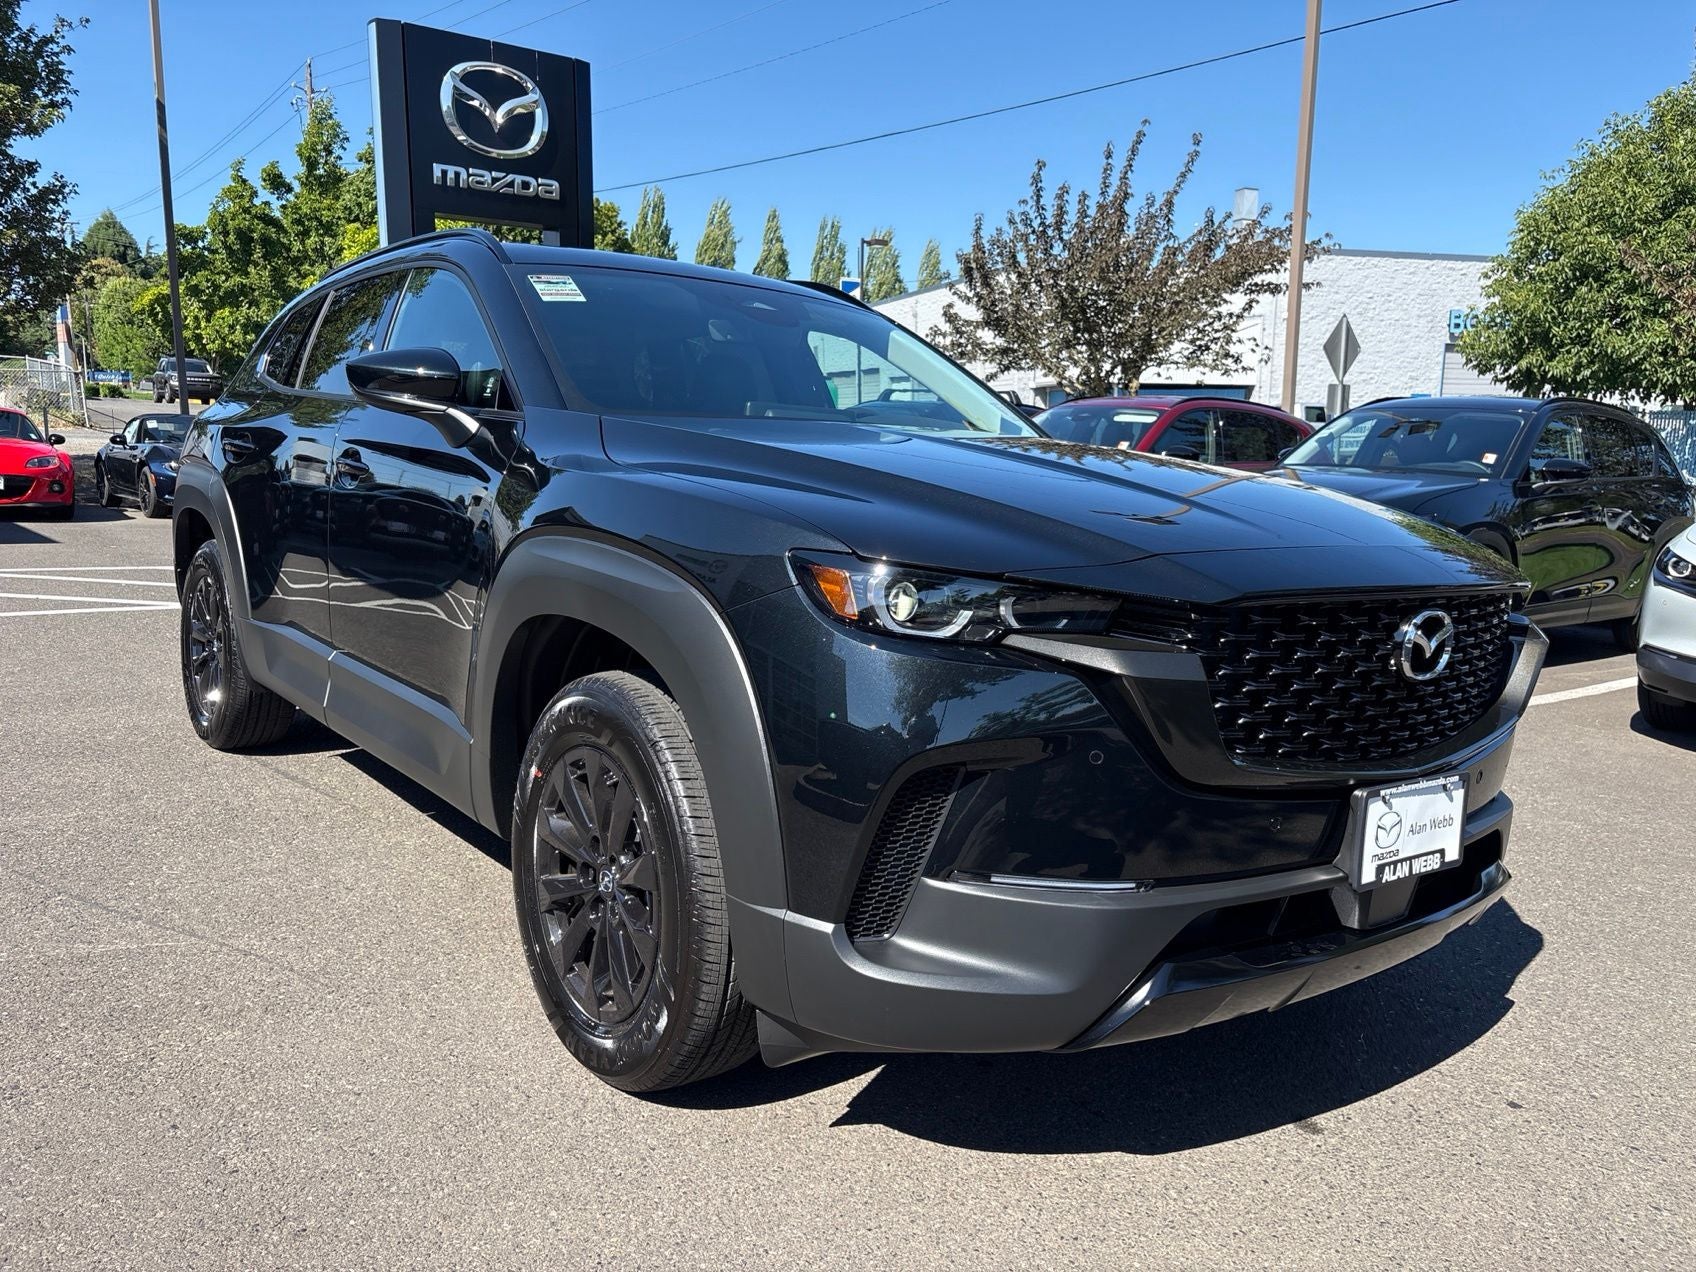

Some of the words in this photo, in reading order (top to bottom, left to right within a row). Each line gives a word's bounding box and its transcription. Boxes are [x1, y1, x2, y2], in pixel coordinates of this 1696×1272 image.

[1407, 821, 1427, 837] Alan
[1430, 814, 1454, 830] Webb
[1382, 861, 1410, 883] ALAN
[1412, 853, 1440, 875] WEBB
